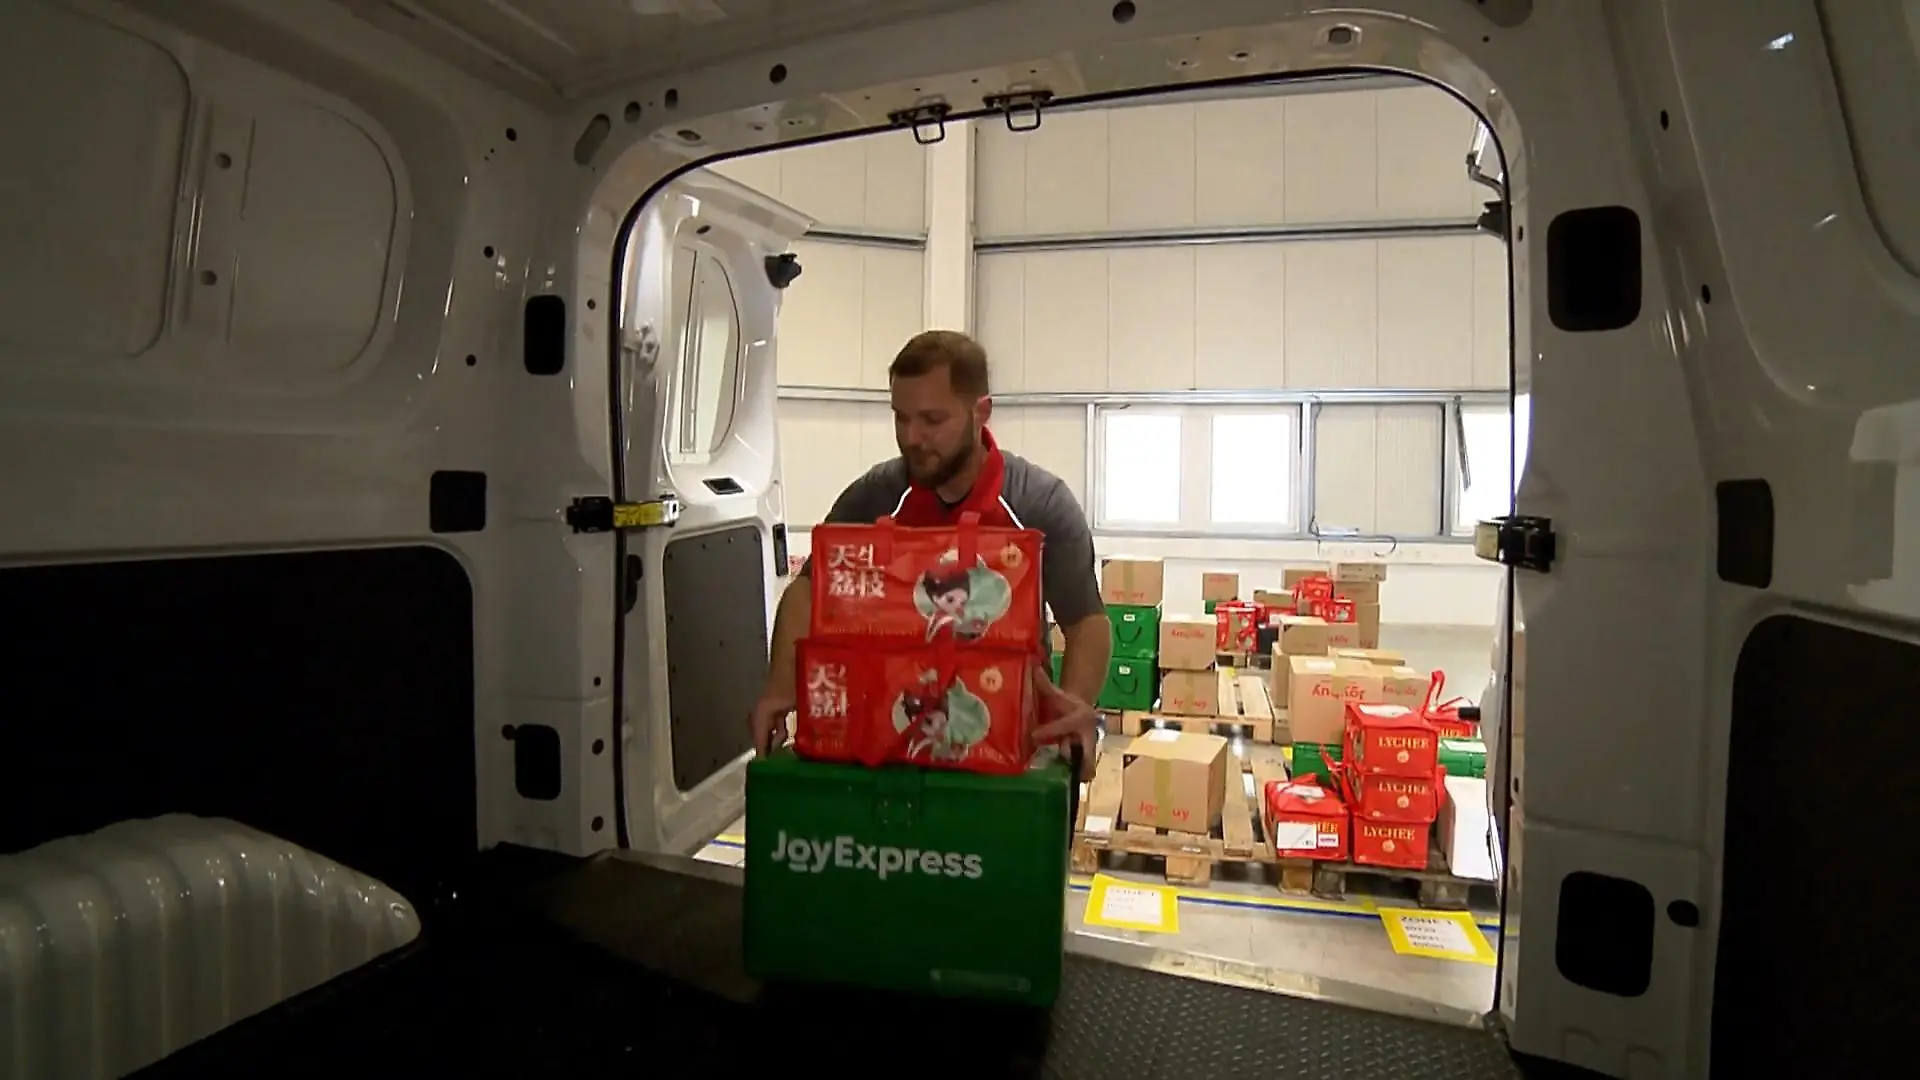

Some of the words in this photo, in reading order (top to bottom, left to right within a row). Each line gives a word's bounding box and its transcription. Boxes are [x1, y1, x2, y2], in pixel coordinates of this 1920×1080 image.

[828, 543, 885, 570] 天生
[807, 663, 847, 690] 天
[1378, 736, 1430, 750] LYCHEE
[1378, 781, 1429, 796] LYCHEE
[1139, 801, 1191, 820] Jouy
[1363, 825, 1416, 842] LYCHEE
[770, 829, 984, 880] JoyExpress
